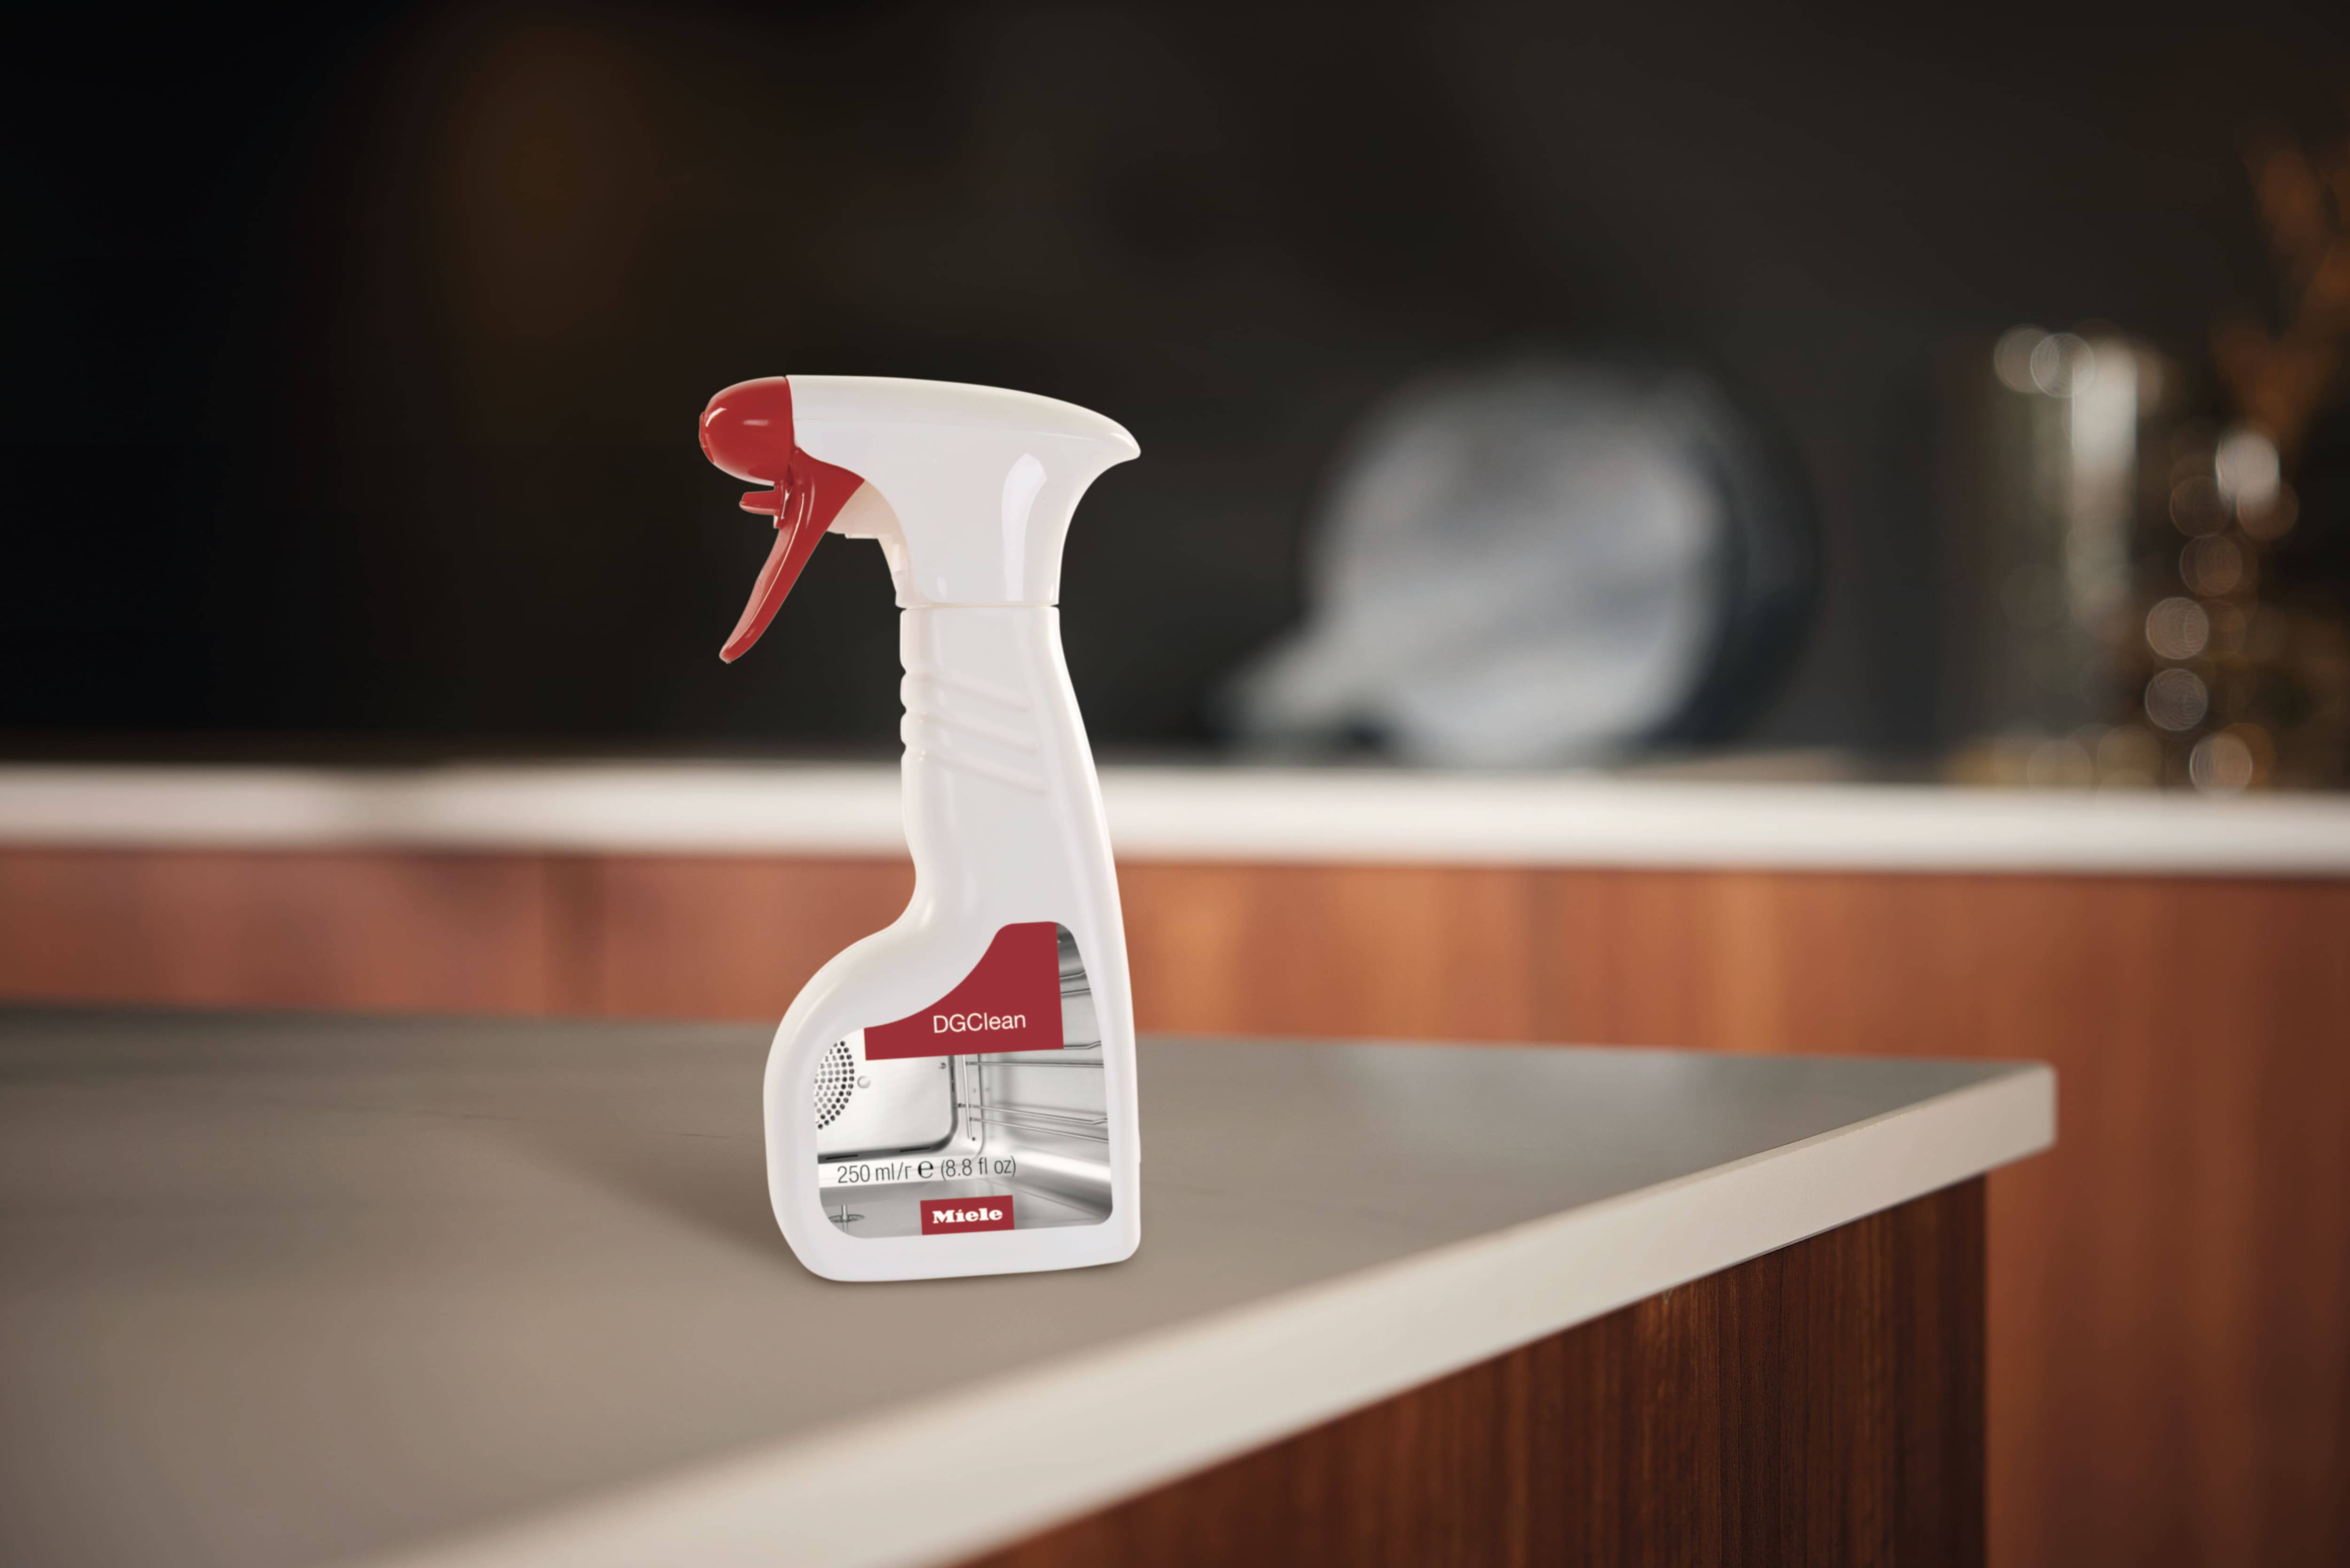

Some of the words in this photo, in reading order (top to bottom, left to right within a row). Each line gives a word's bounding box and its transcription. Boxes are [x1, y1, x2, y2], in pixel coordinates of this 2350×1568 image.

[933, 1012, 1026, 1034] DGClean
[838, 1164, 870, 1183] 250
[940, 1158, 972, 1181] (8.8
[978, 1157, 987, 1175] fl
[994, 1155, 1016, 1177] oz)
[932, 1207, 1003, 1224] Miele
